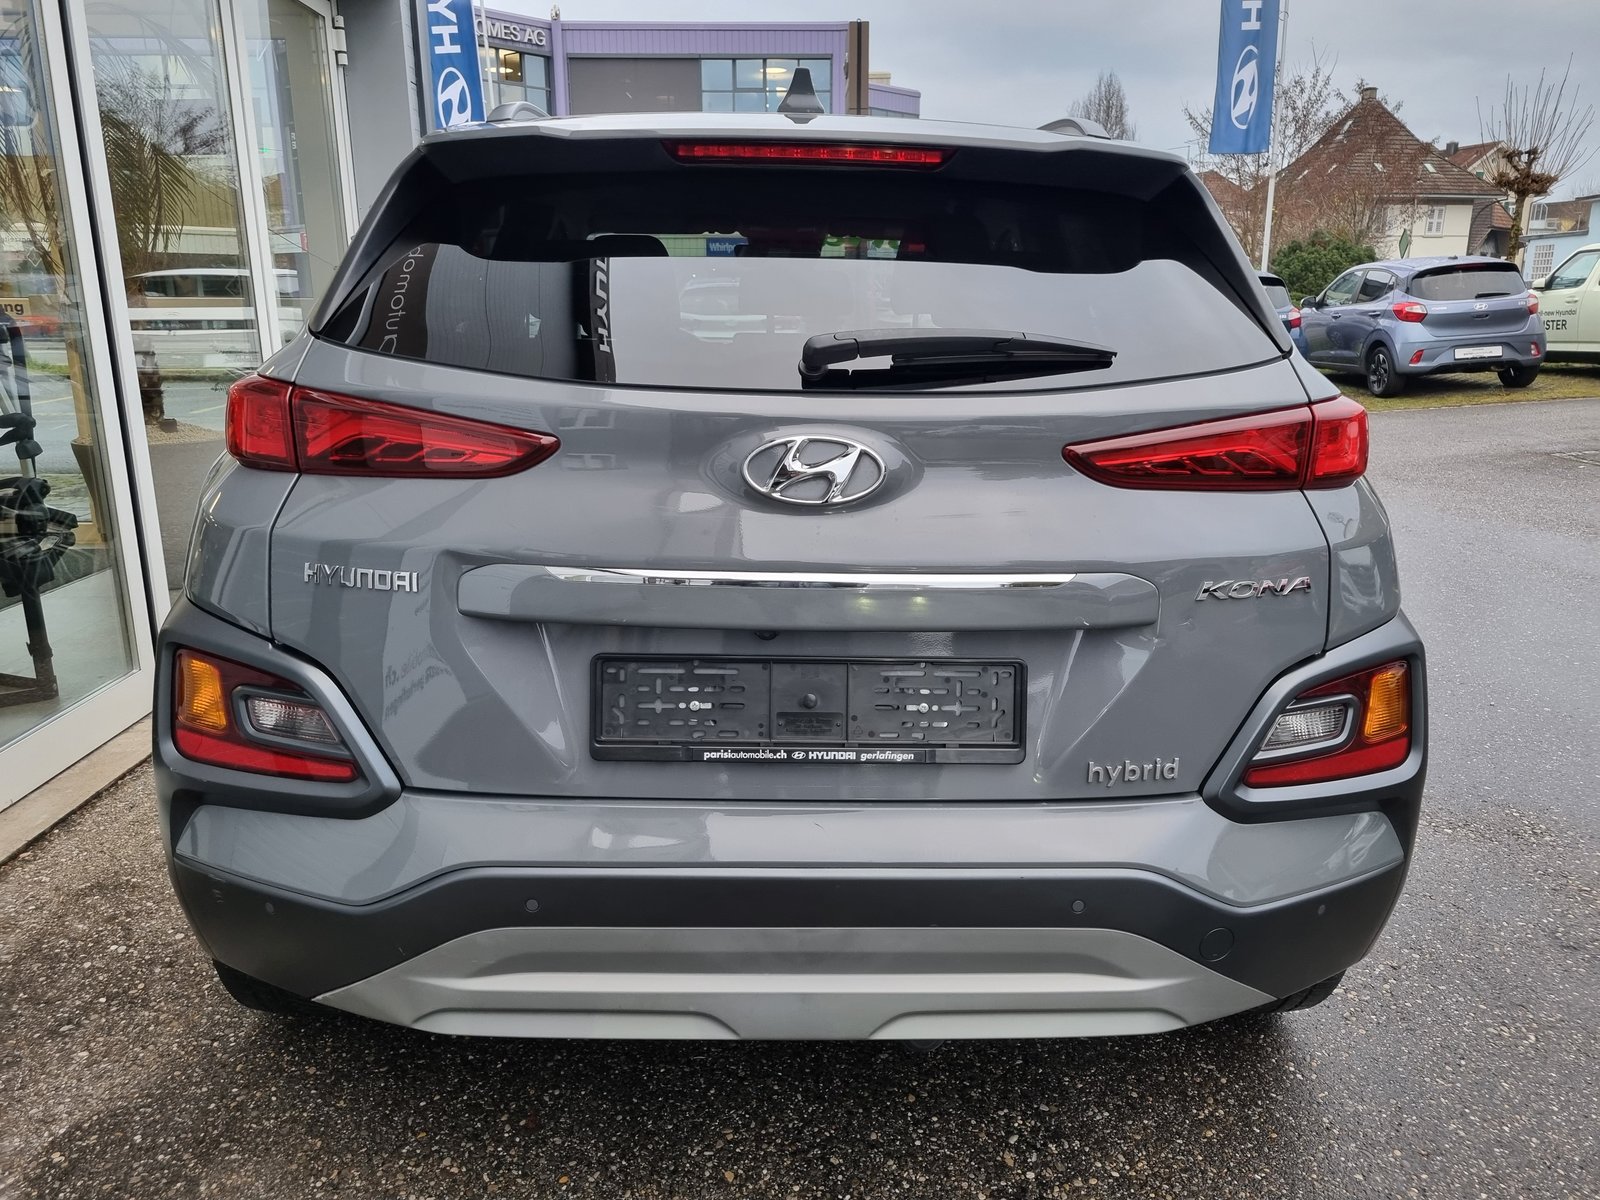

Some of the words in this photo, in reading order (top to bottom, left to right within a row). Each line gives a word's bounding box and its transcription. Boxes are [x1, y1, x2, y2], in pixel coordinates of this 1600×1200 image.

[523, 28, 546, 46] AG
[0, 303, 24, 315] ng
[1543, 319, 1567, 331] STER
[304, 562, 419, 593] HYUNDAI
[1194, 576, 1312, 601] KONA
[703, 749, 787, 760] parisiautomobile.ch
[808, 751, 856, 760] HYUNDAI
[860, 751, 915, 762] gerlafingen
[1087, 757, 1180, 788] hybrid
